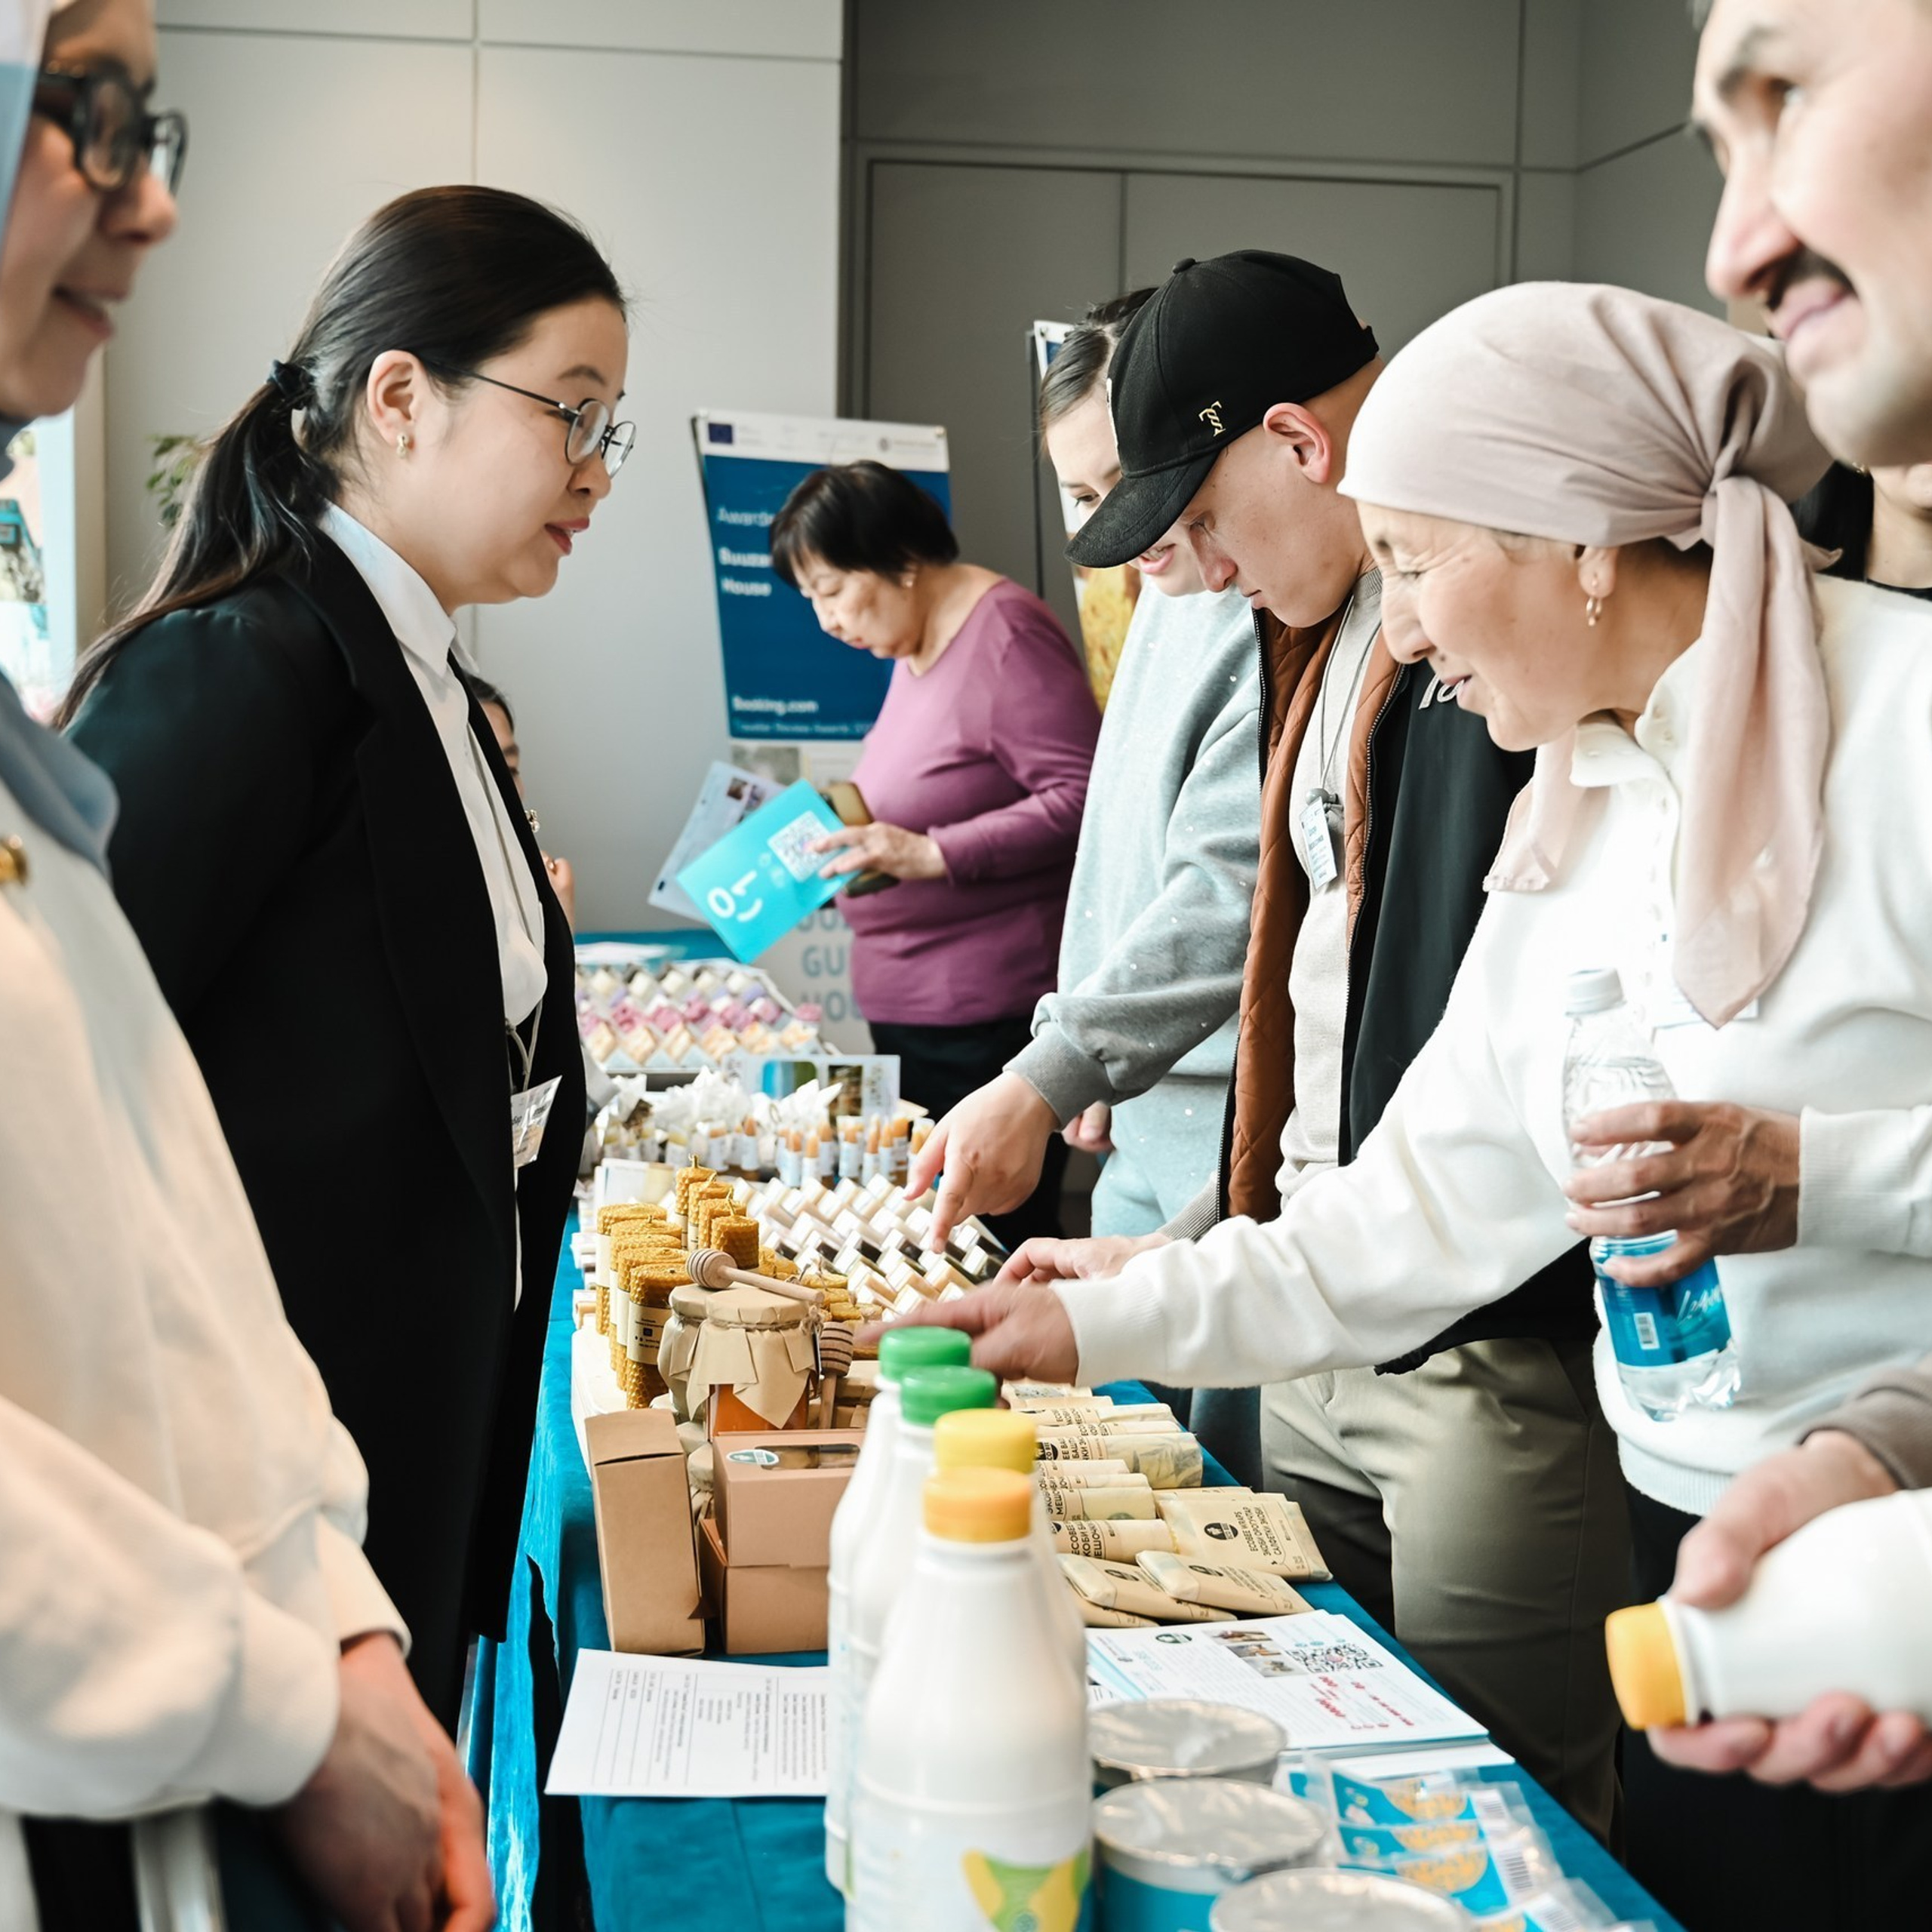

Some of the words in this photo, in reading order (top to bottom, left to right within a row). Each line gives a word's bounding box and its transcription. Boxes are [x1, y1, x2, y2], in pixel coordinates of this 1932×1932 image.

[721, 577, 772, 596] House
[732, 696, 820, 716] Booking.com
[1234, 1511, 1248, 1530] WRAPS
[1242, 1531, 1259, 1552] ECOBEE
[1257, 1537, 1272, 1556] ЭКОБИ
[1263, 1525, 1282, 1555] САЛФЕТКИ
